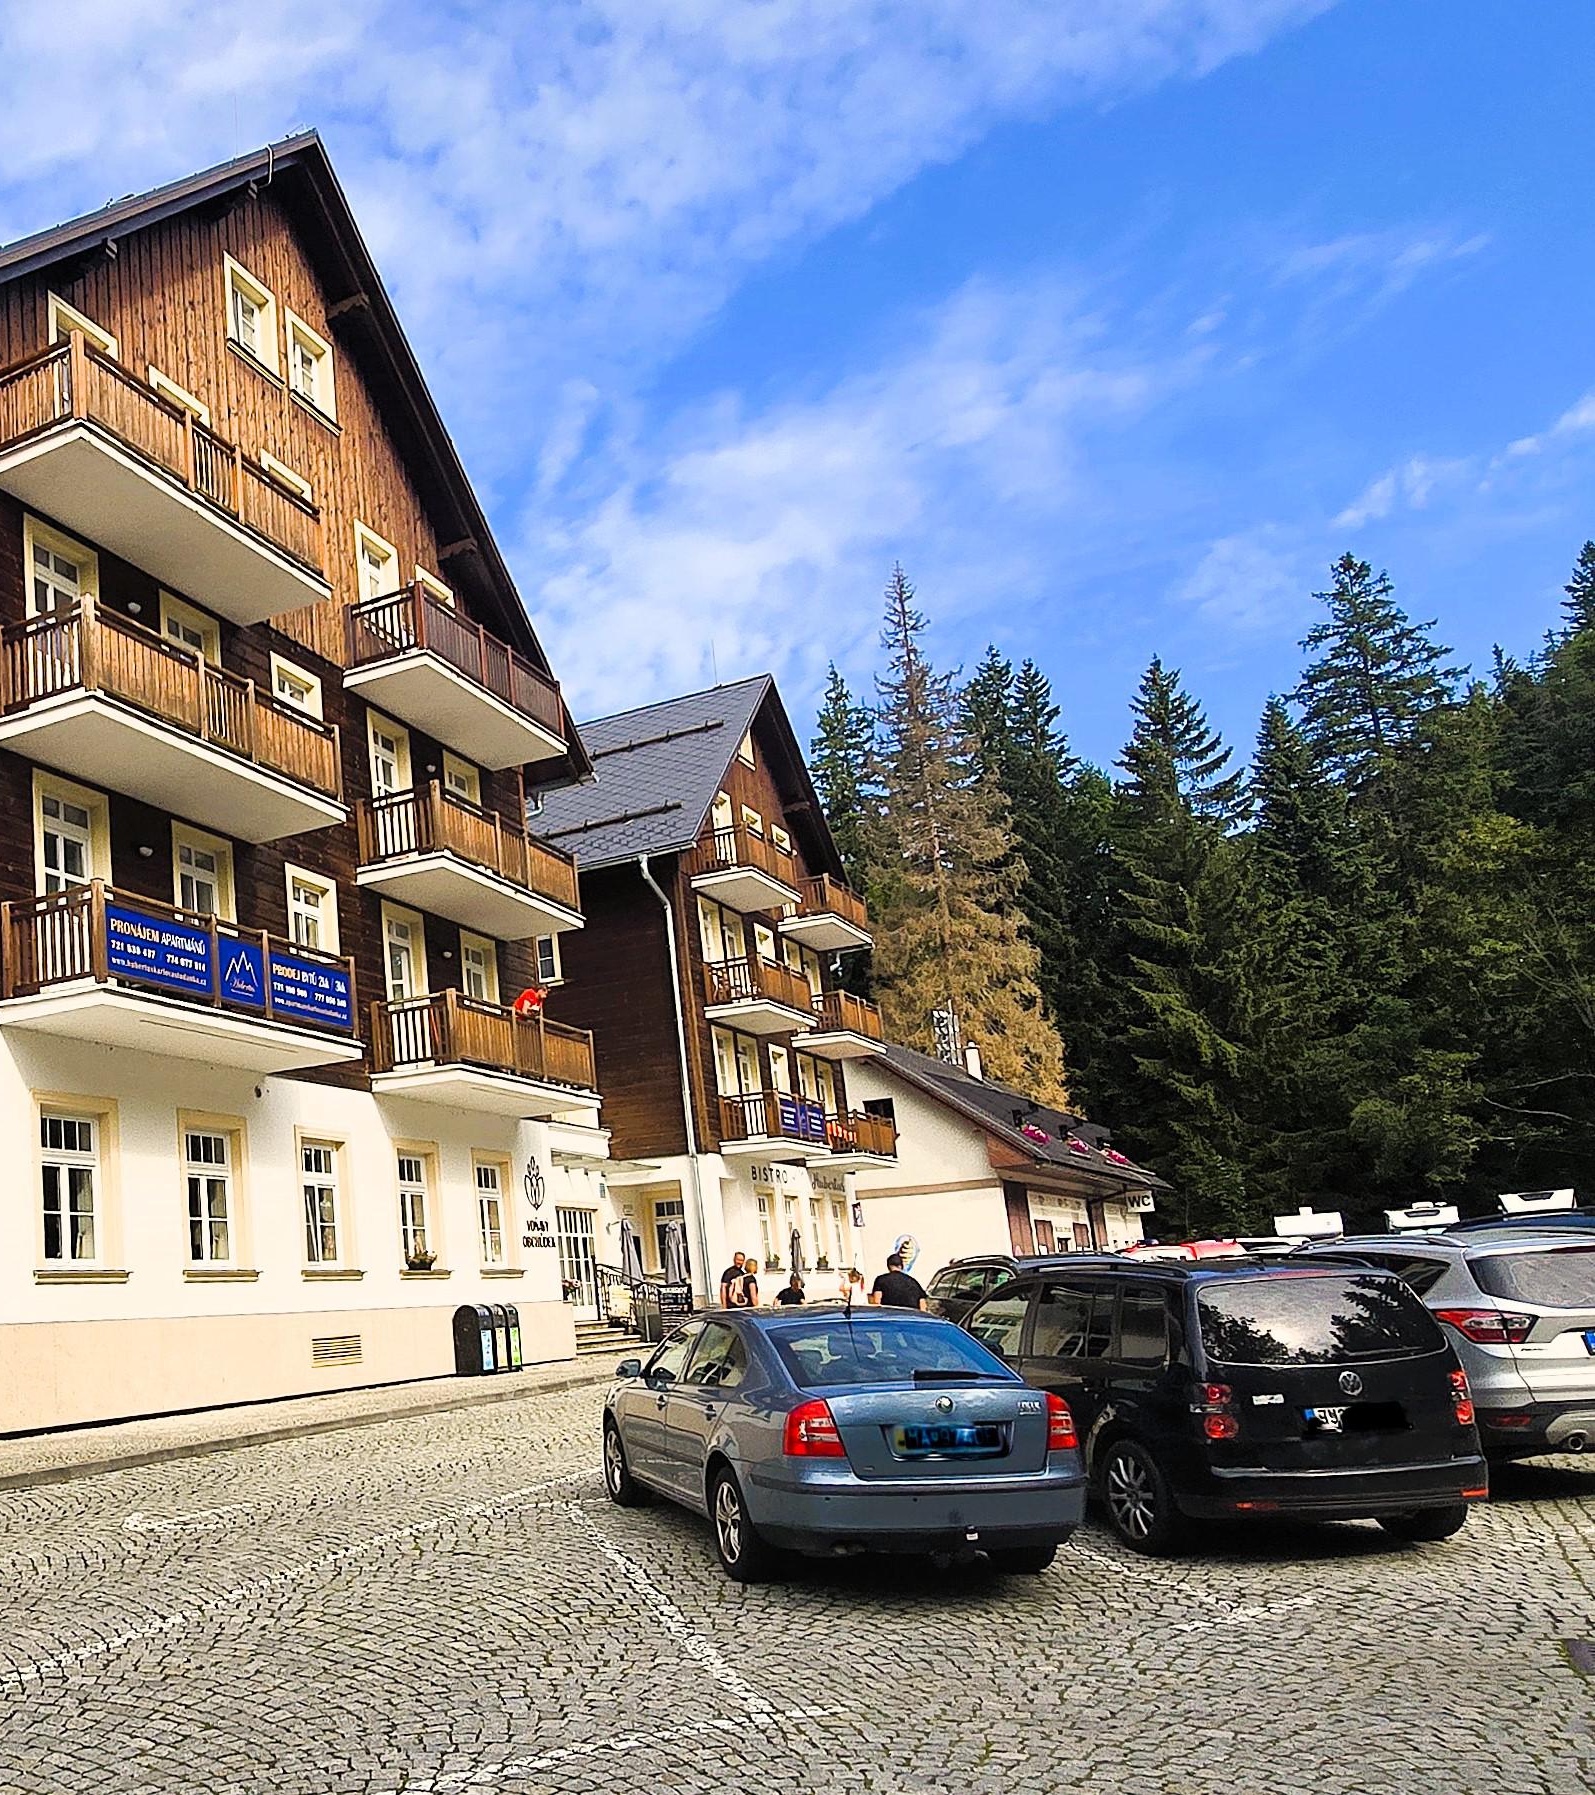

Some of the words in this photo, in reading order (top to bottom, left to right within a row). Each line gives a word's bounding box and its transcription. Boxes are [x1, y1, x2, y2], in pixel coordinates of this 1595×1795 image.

[110, 918, 160, 943] PRONÁJEM
[160, 932, 206, 955] APARTMÁNŮ
[751, 1165, 788, 1183] BISTRO
[1127, 1194, 1151, 1209] WC
